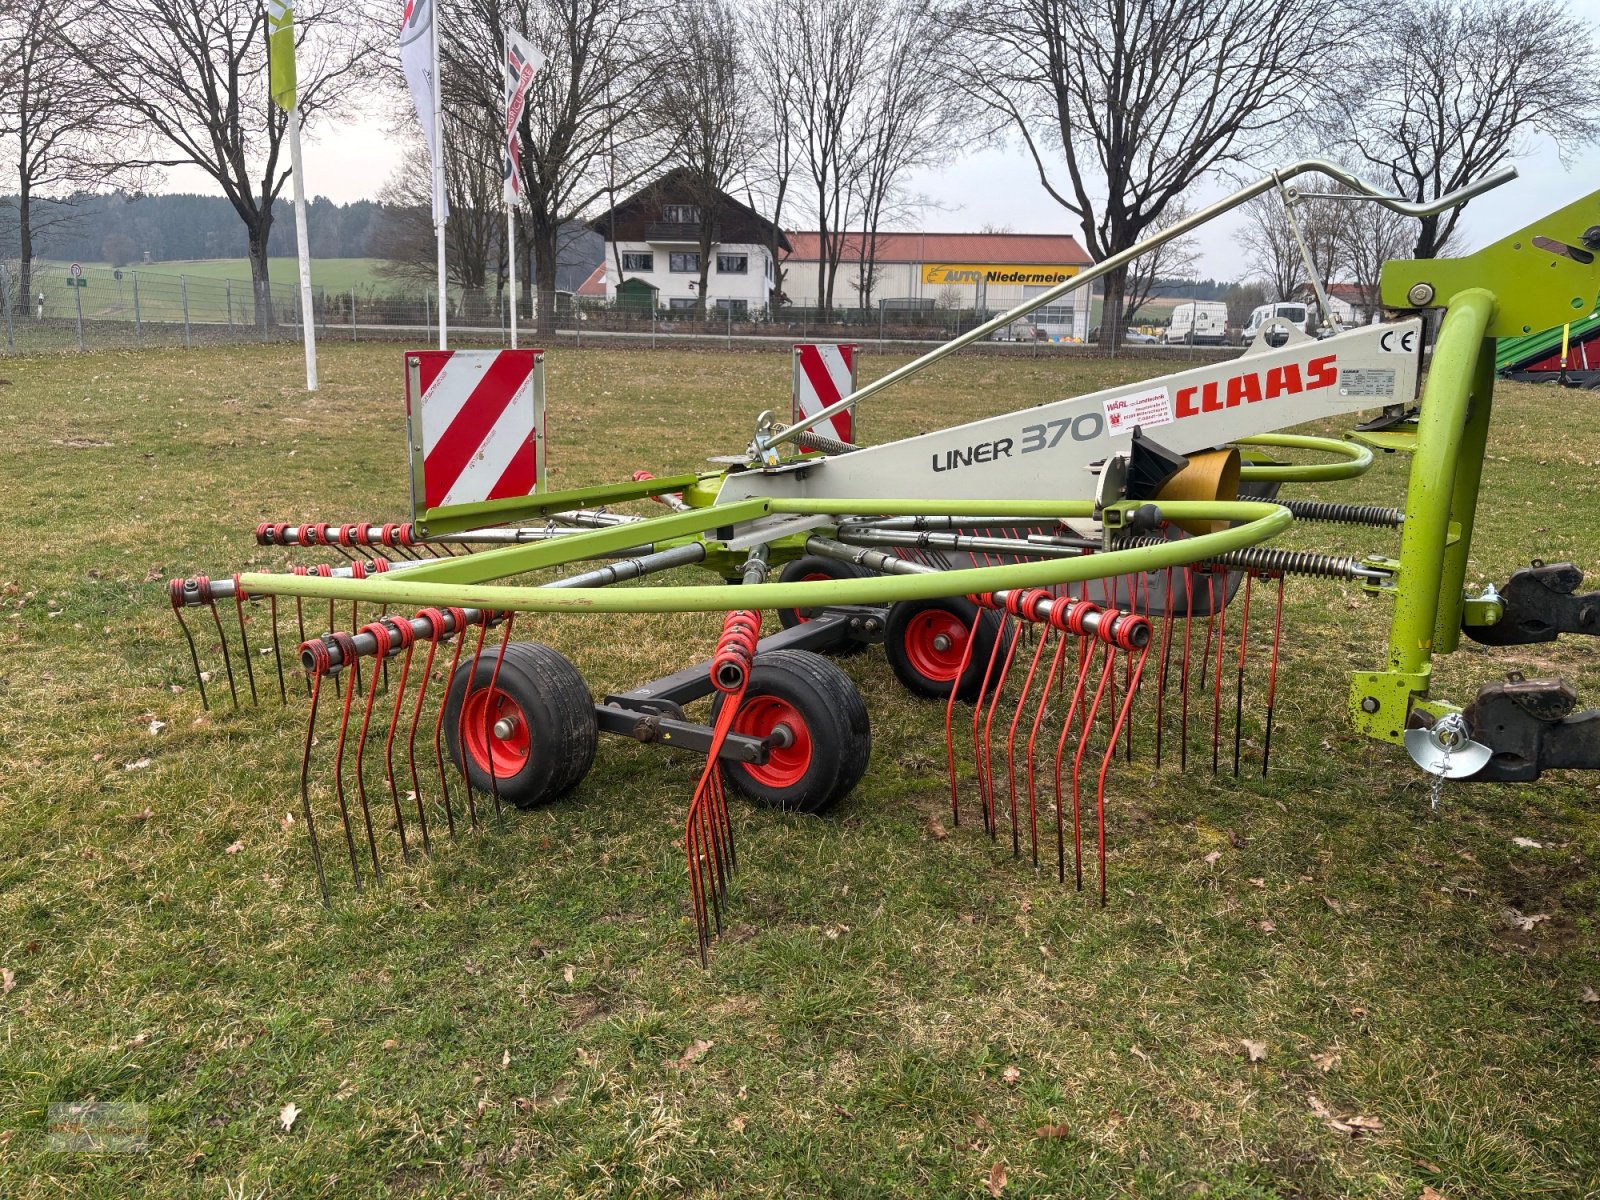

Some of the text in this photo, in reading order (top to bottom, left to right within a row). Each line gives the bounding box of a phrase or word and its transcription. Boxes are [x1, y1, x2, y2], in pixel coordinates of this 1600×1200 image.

[943, 271, 1073, 283] AUTO Niedermeier
[1175, 354, 1338, 419] CLAAS
[1107, 400, 1128, 411] WÄRL
[932, 412, 1104, 472] LINER 370
